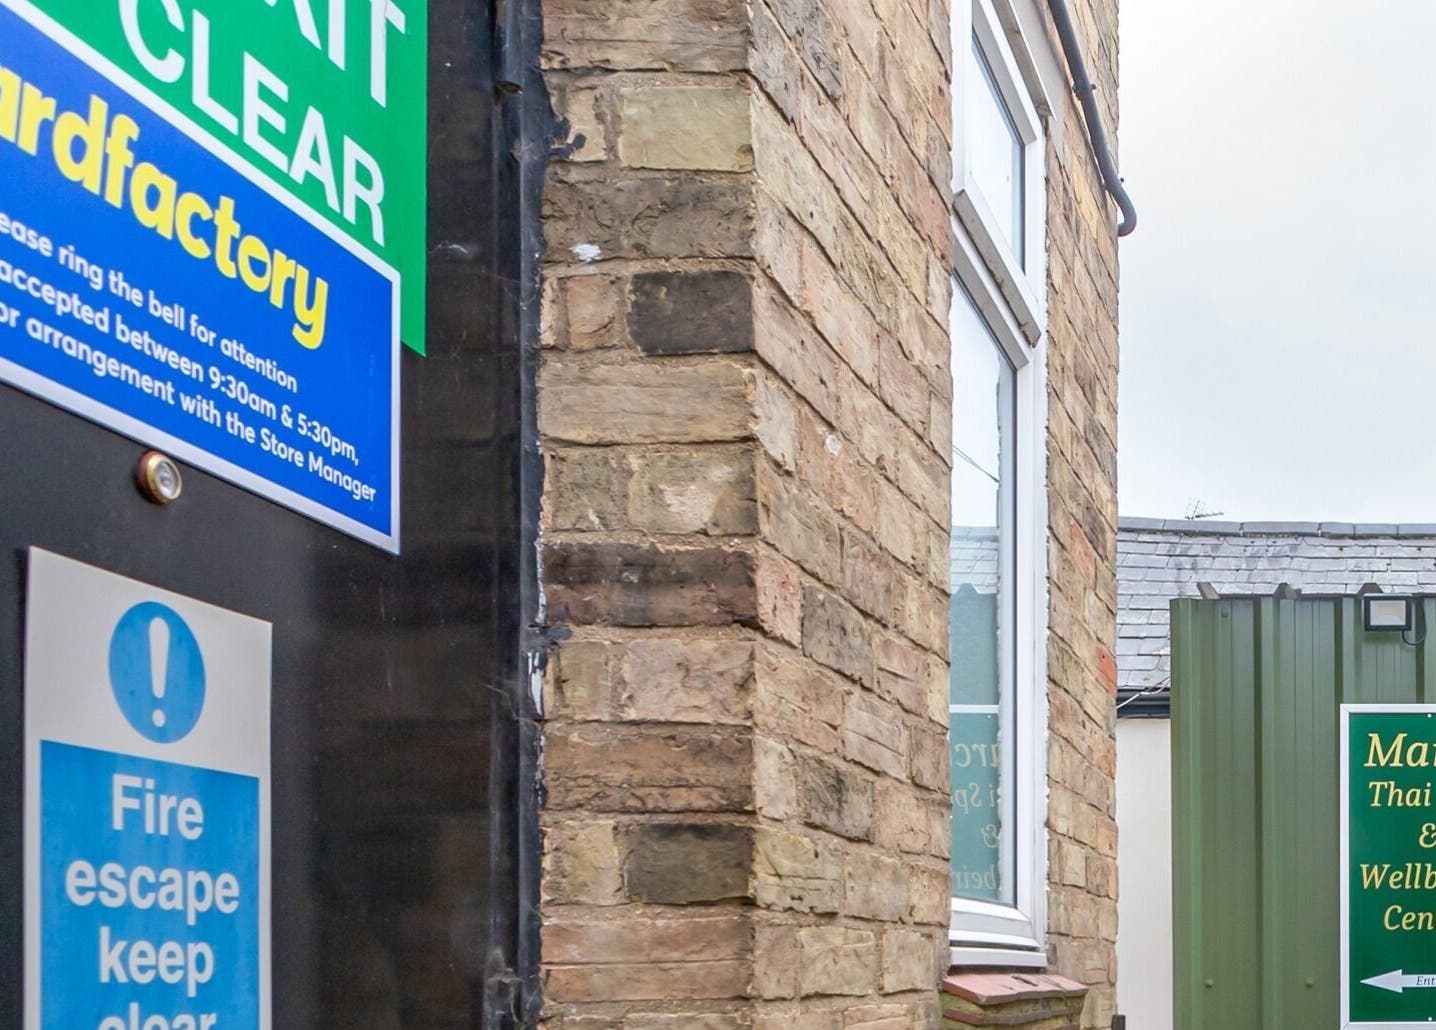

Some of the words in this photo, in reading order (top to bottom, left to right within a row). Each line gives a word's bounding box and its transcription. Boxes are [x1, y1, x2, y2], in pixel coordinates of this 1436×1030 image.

[264, 0, 406, 109] IT
[119, 0, 385, 247] CLEAR
[0, 260, 110, 334] accepted
[115, 313, 204, 382] between
[208, 366, 277, 421] 9:30am
[281, 404, 294, 430] &
[297, 412, 359, 467] 5:30pm,
[58, 245, 104, 291] ring
[109, 269, 143, 307] the
[149, 289, 185, 331] bell
[190, 313, 217, 347] for
[220, 338, 297, 393] attention
[26, 317, 175, 405] arrangement
[180, 392, 221, 428] with
[225, 411, 256, 444] the
[260, 427, 304, 467] Store
[308, 451, 377, 502] Manager
[112, 773, 204, 840] Fire
[1368, 781, 1432, 807] Thai
[65, 859, 240, 925] escape
[99, 926, 215, 998] keep
